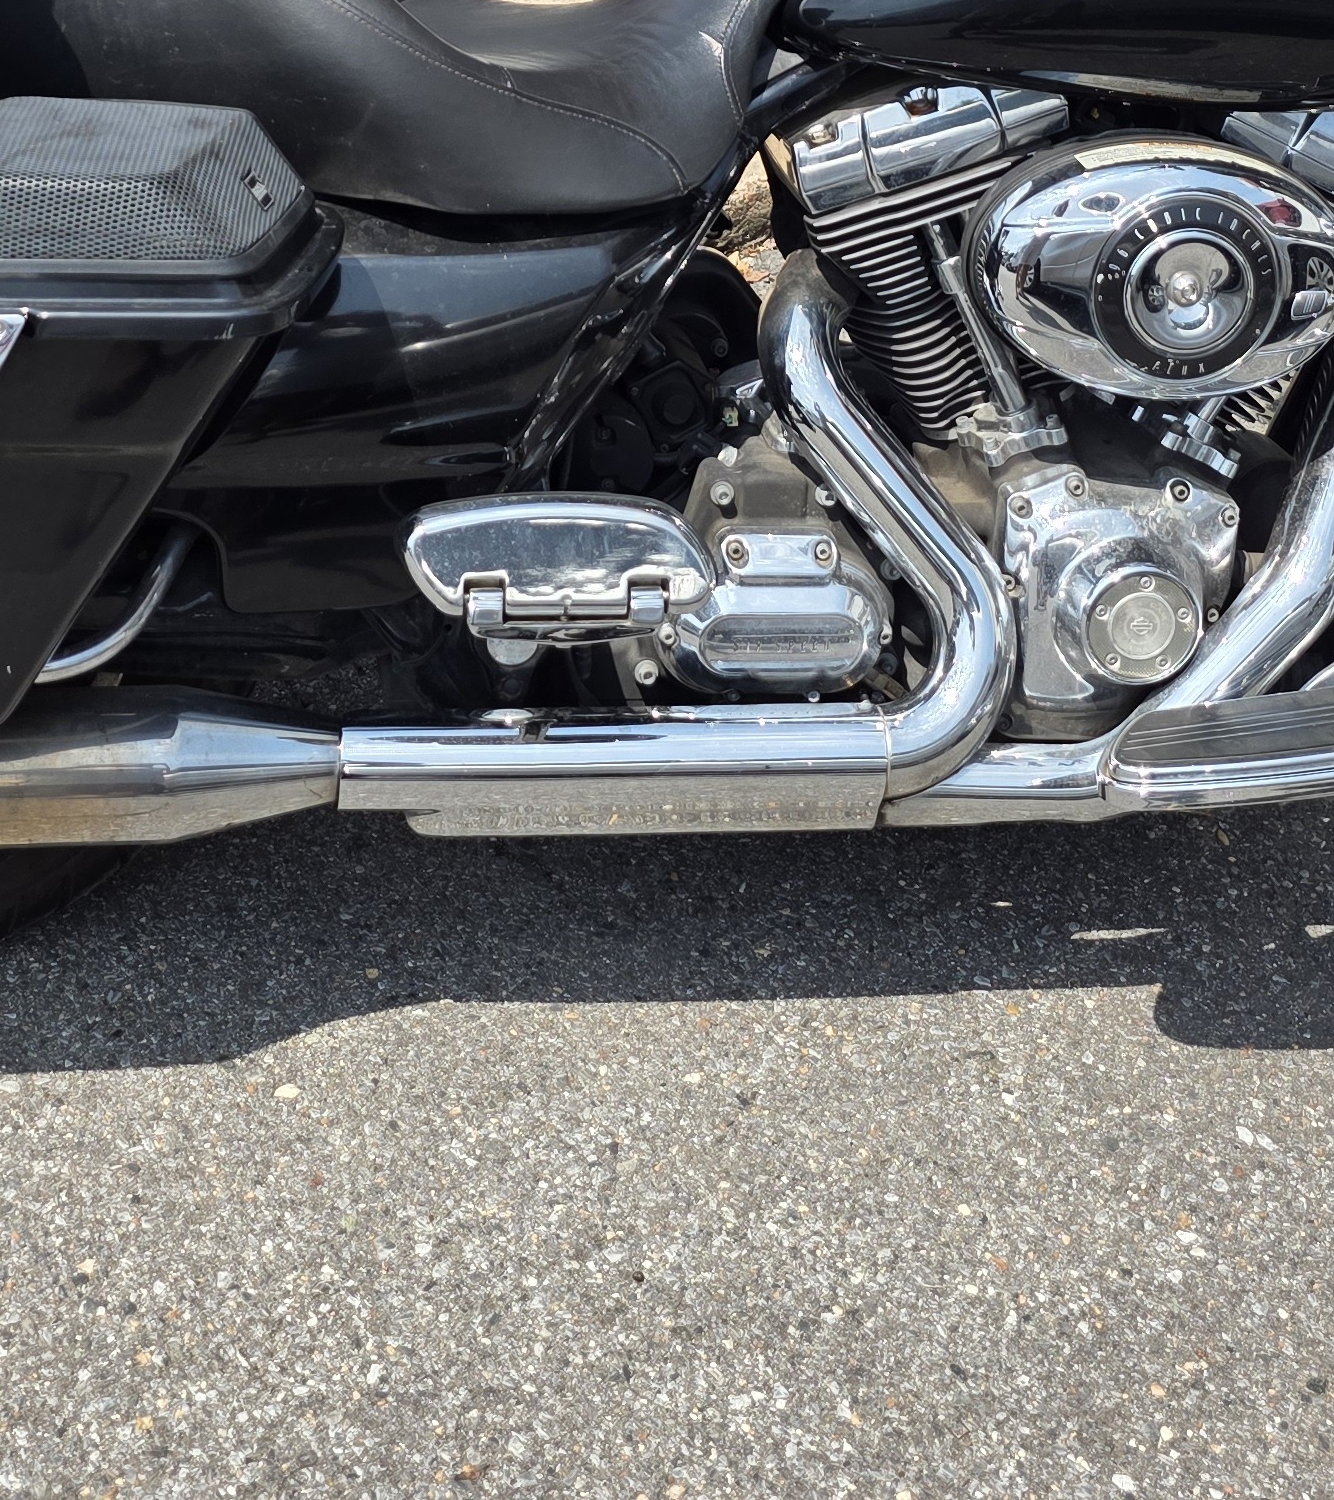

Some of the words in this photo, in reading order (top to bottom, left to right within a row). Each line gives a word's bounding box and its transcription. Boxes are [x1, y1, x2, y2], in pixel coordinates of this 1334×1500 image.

[1108, 248, 1129, 271] 96
[1134, 207, 1201, 240] CUBIC
[732, 640, 763, 652] SIX
